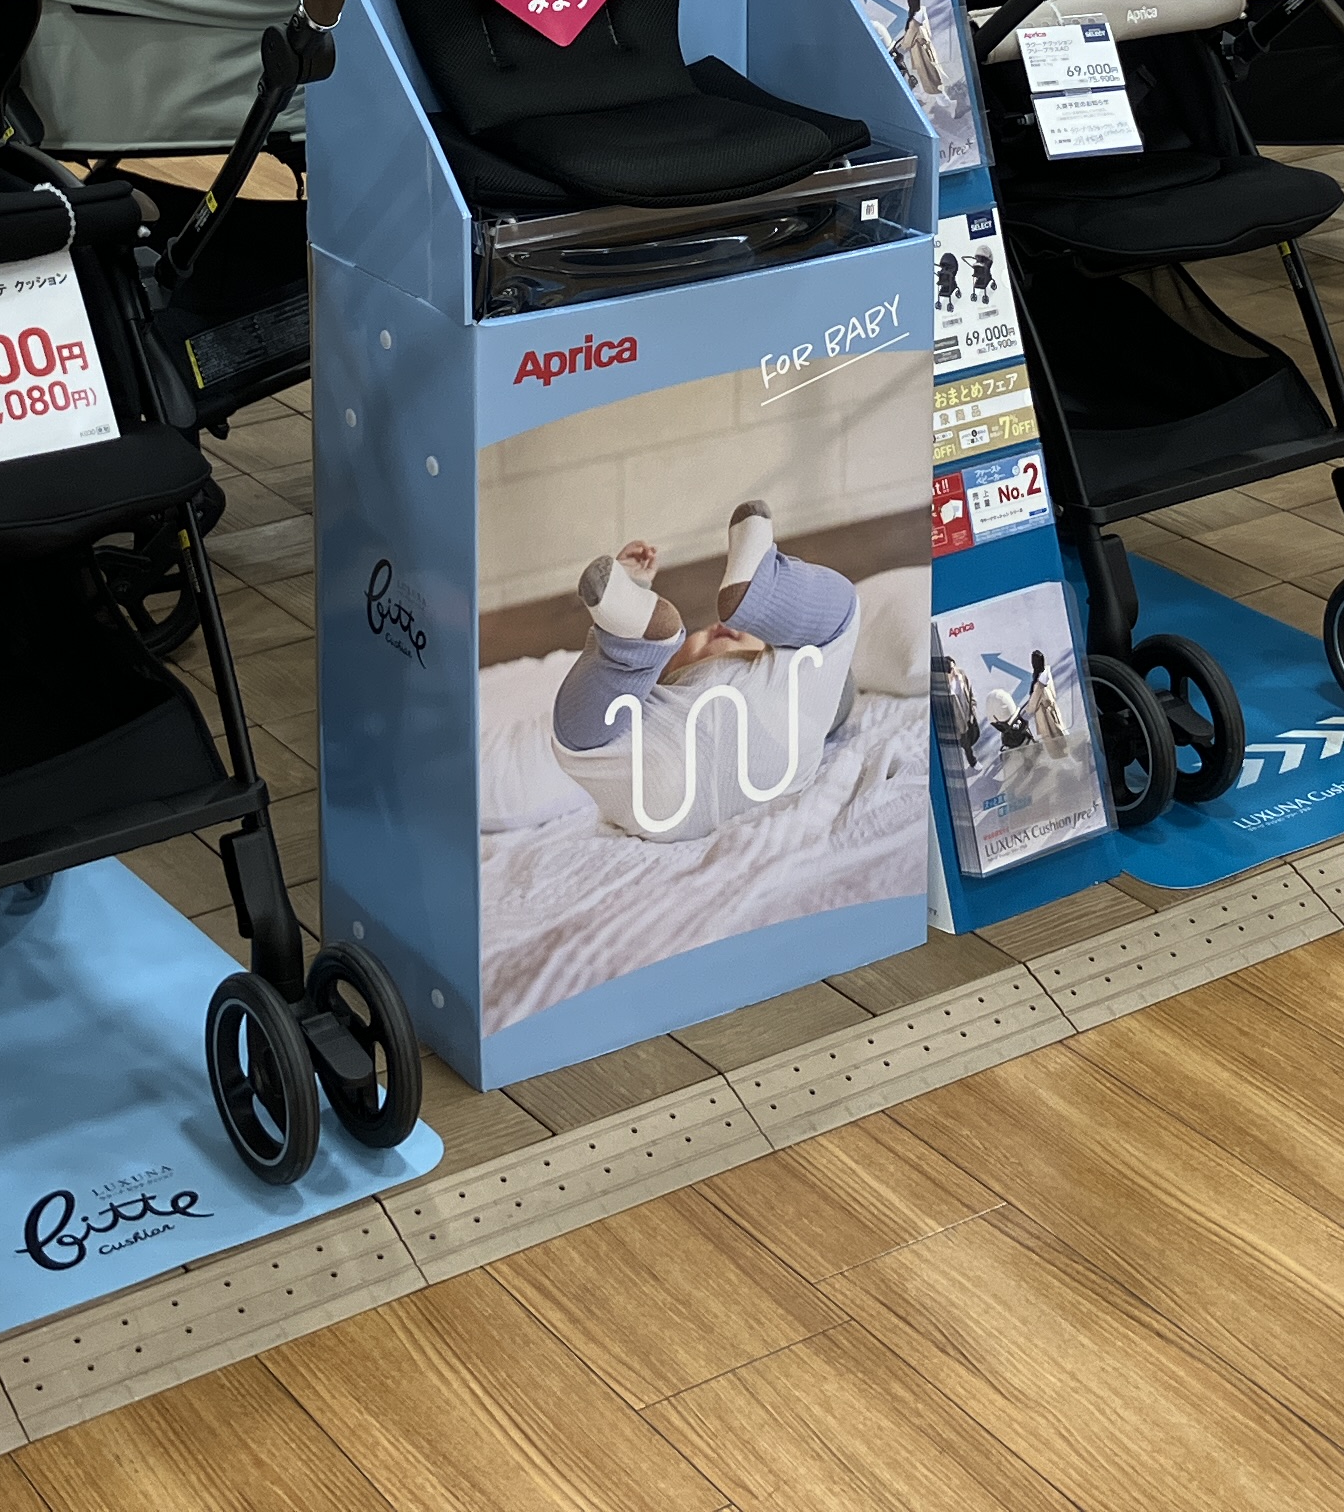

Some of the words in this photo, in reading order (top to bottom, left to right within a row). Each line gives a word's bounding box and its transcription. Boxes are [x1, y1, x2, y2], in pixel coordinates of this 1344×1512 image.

[1126, 5, 1158, 25] Aprica
[1023, 31, 1047, 39] Aprica
[1066, 63, 1119, 78] 69,000円
[14, 272, 68, 294] クッション
[760, 345, 811, 389] FOR
[823, 294, 903, 354] BABY
[964, 324, 1016, 348] 69,000円
[513, 333, 639, 387] Aprica
[934, 373, 1019, 409] おまとめフェア
[997, 461, 1043, 505] No.2
[948, 621, 975, 639] Aprica
[1232, 797, 1311, 831] LUXUNA
[984, 830, 1031, 858] LUXUNA
[1030, 817, 1072, 841] Cushion
[90, 1163, 174, 1197] LUXUNA
